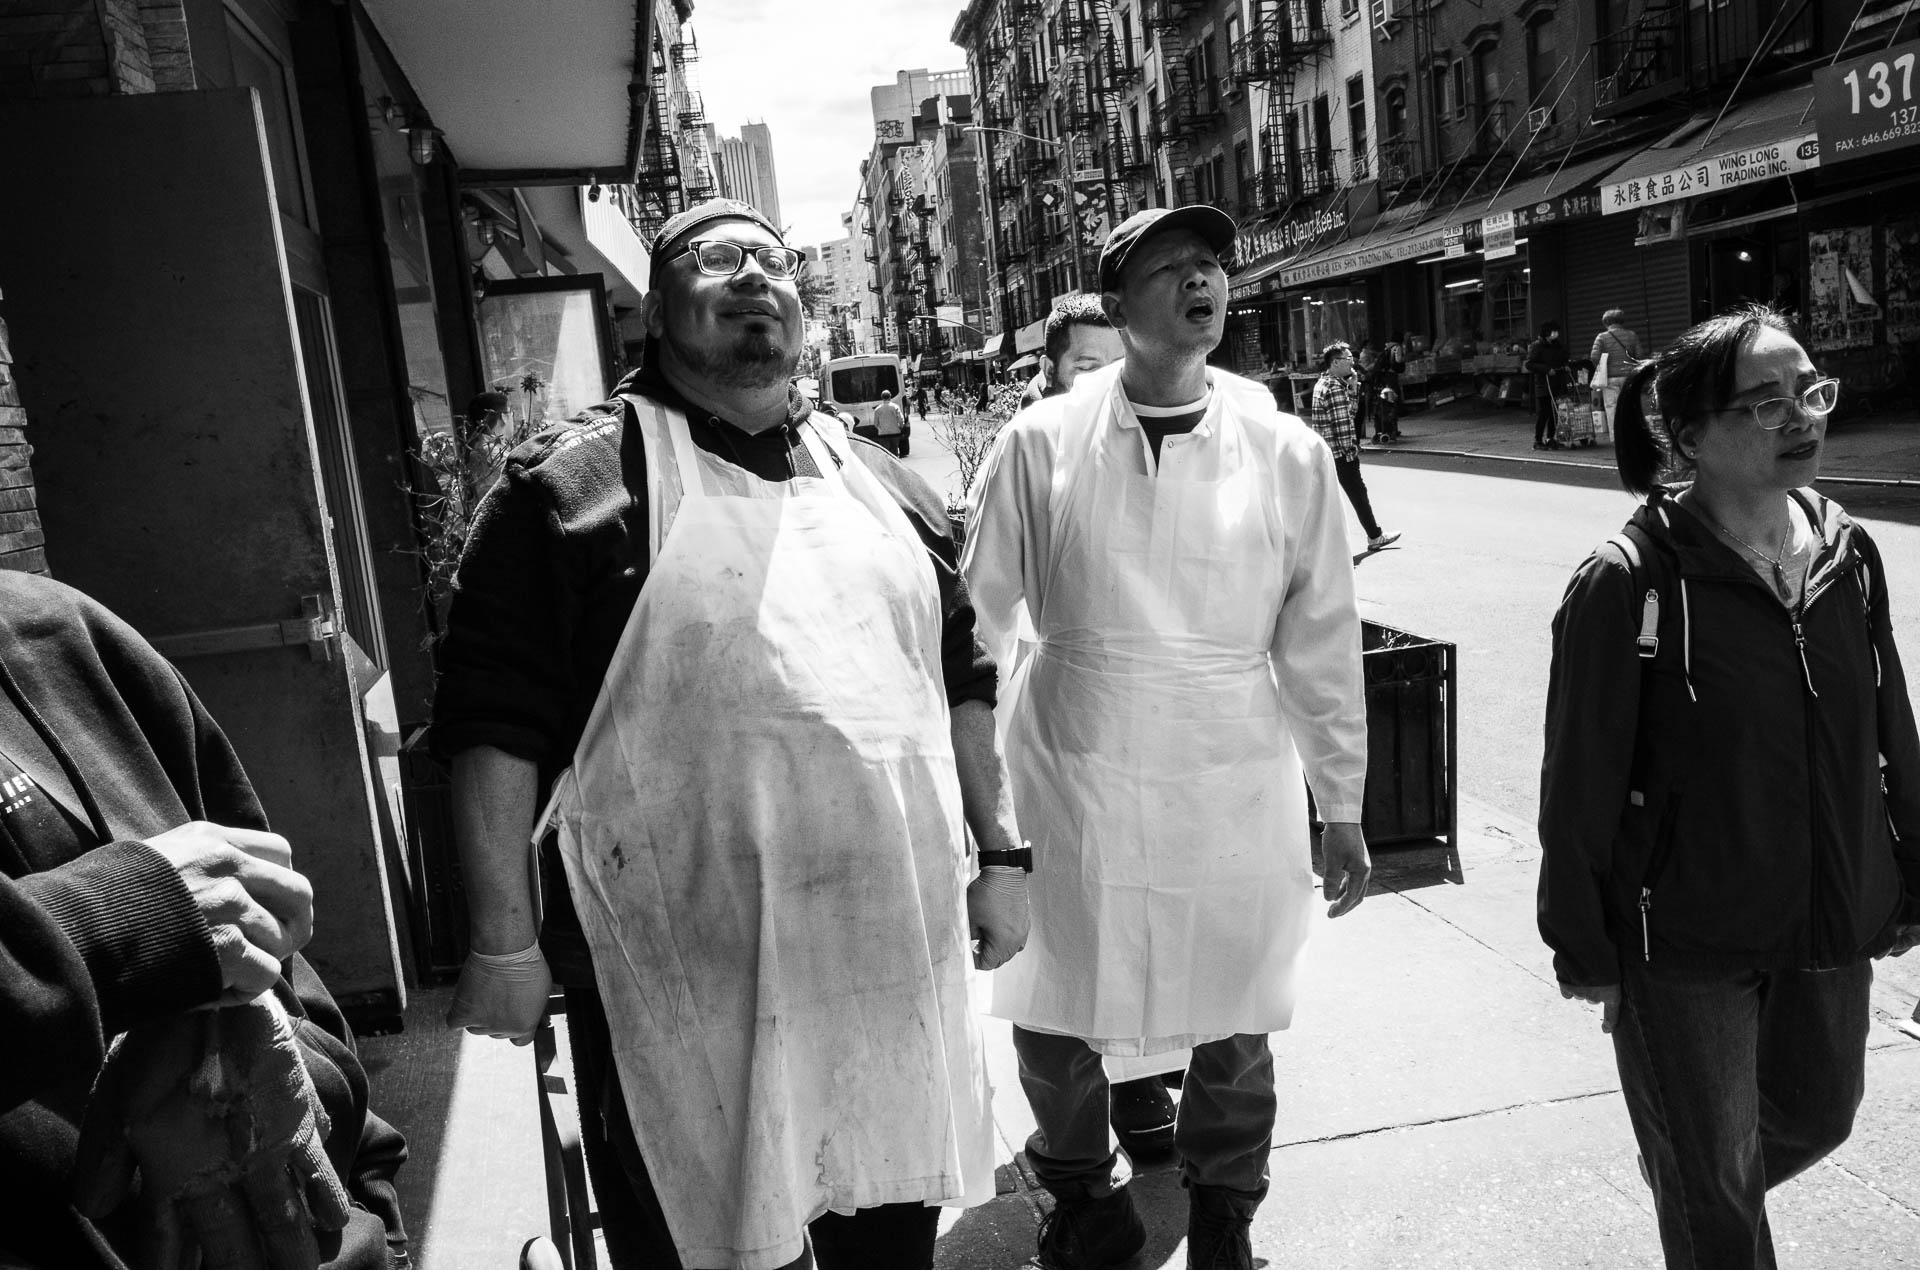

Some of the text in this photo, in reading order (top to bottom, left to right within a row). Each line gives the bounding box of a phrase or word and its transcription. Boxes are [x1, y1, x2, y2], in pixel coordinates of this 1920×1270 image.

[1843, 53, 1915, 114] 137
[1890, 105, 1918, 126] 137
[1801, 143, 1819, 157] 135
[1836, 139, 1854, 152] FAX
[1719, 148, 1779, 171] WING LONG
[1720, 160, 1791, 185] TRADING INC.
[1613, 166, 1710, 206] 永隆食品公司
[1290, 218, 1315, 246] Qiang
[1315, 209, 1333, 234] Kee
[1358, 253, 1382, 267] TRADING
